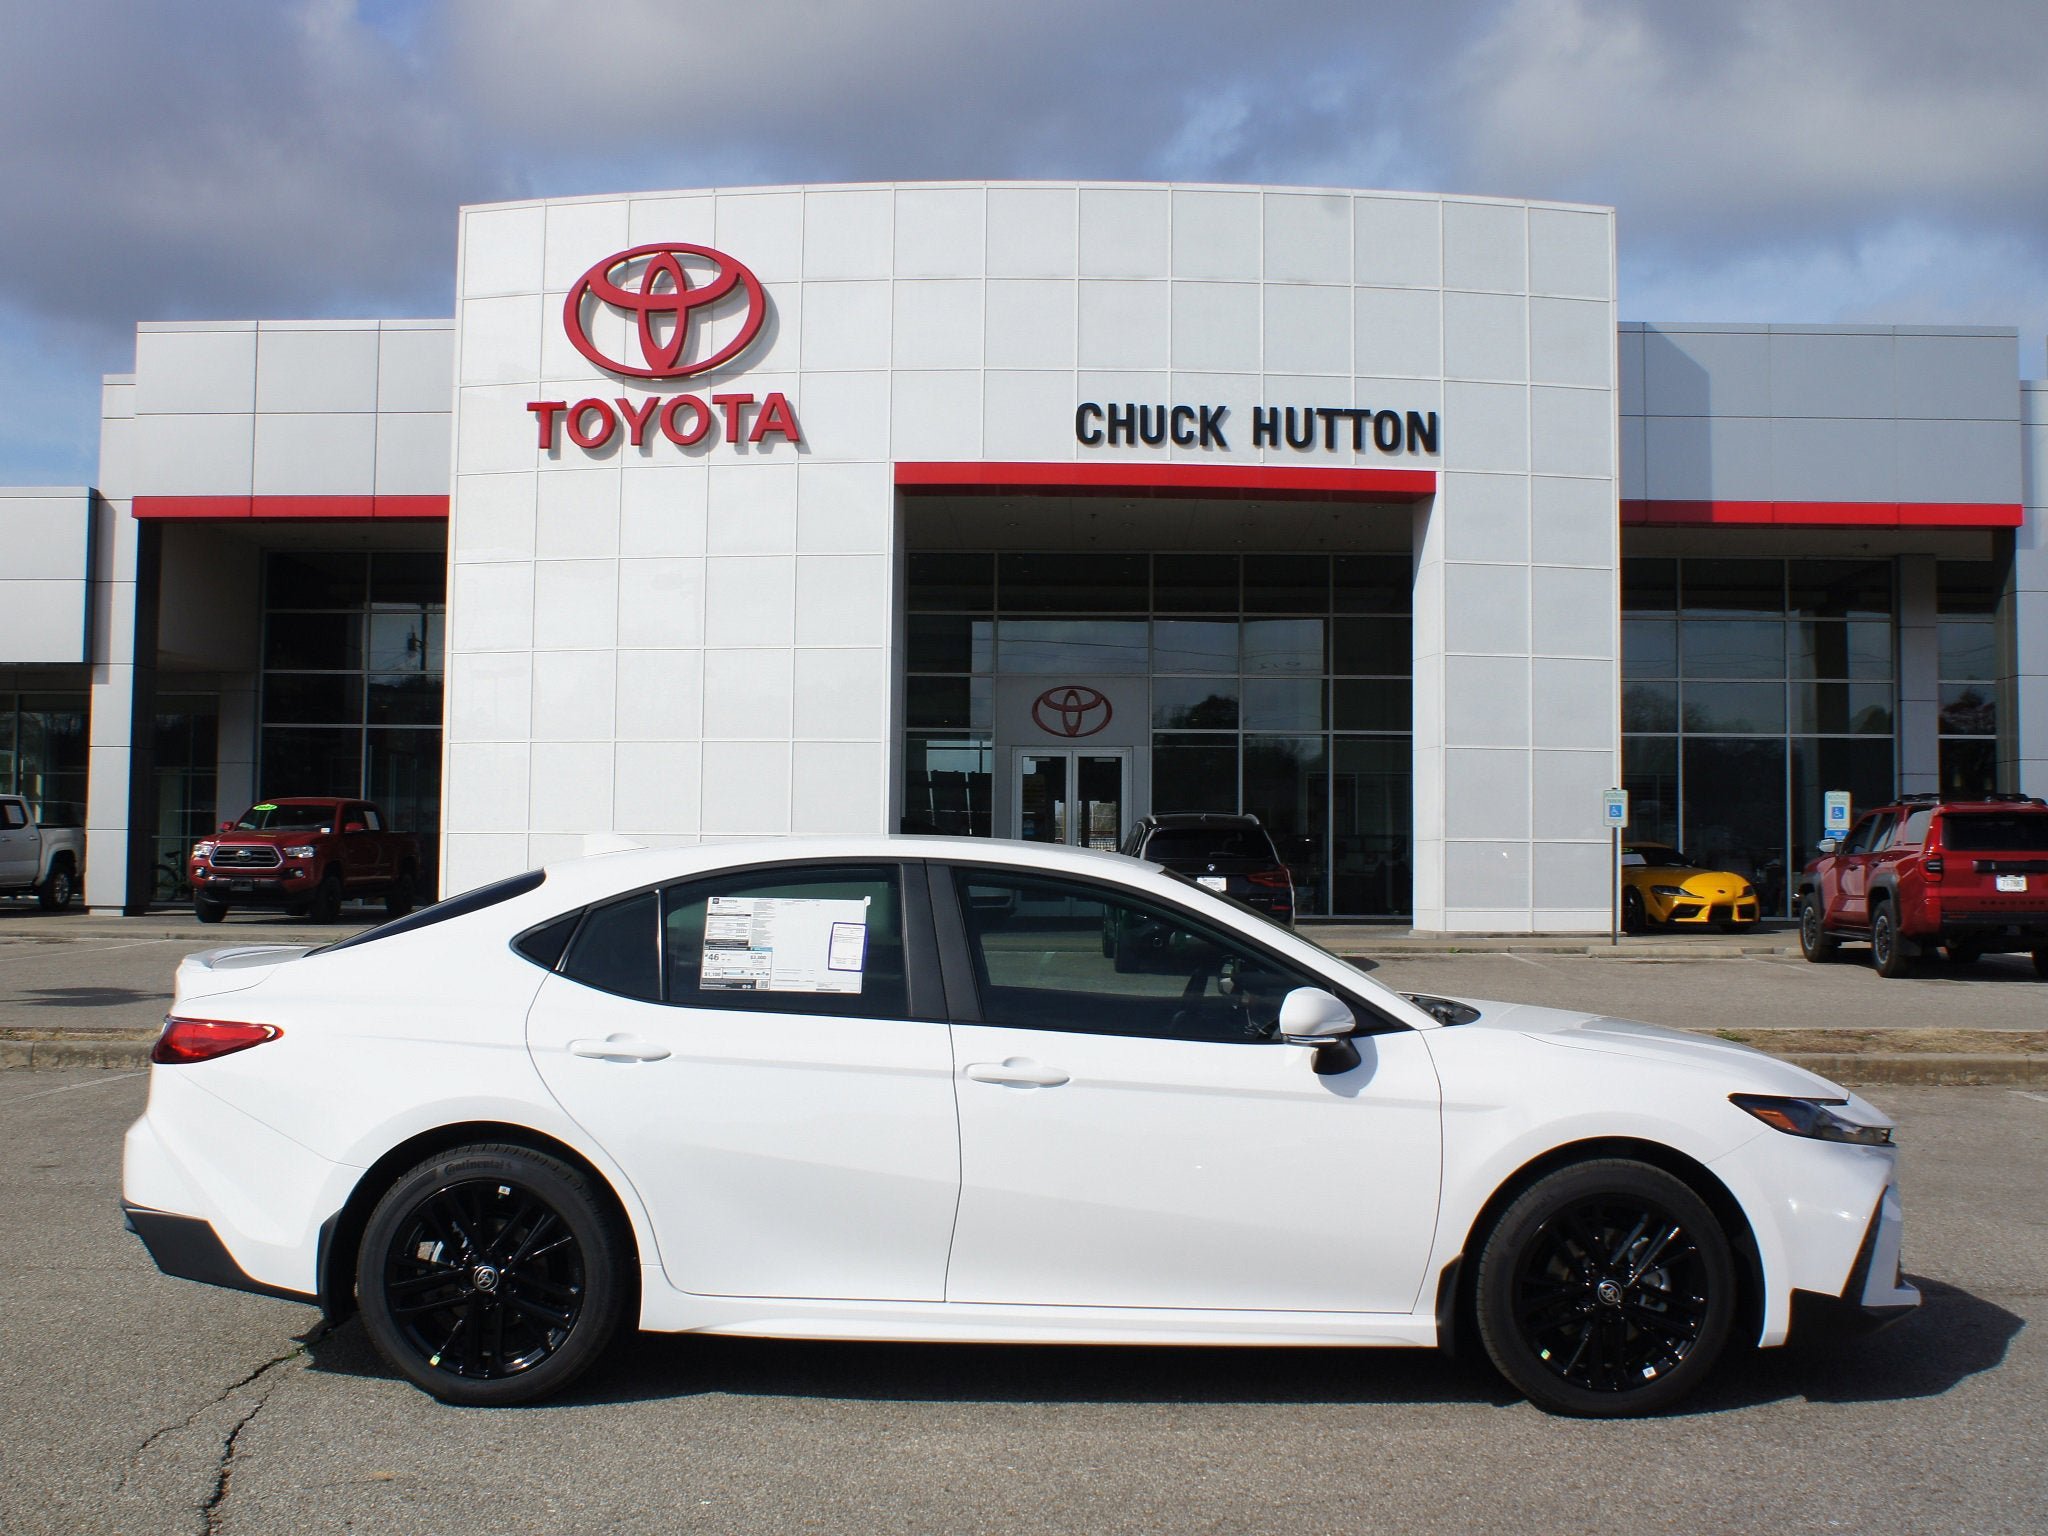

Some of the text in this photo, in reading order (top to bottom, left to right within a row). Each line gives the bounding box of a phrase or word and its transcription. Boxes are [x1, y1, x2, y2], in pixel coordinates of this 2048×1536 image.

[526, 392, 801, 450] TOYOTA
[1075, 402, 1437, 453] CHUCK HUTTON
[444, 1160, 504, 1175] Continental
